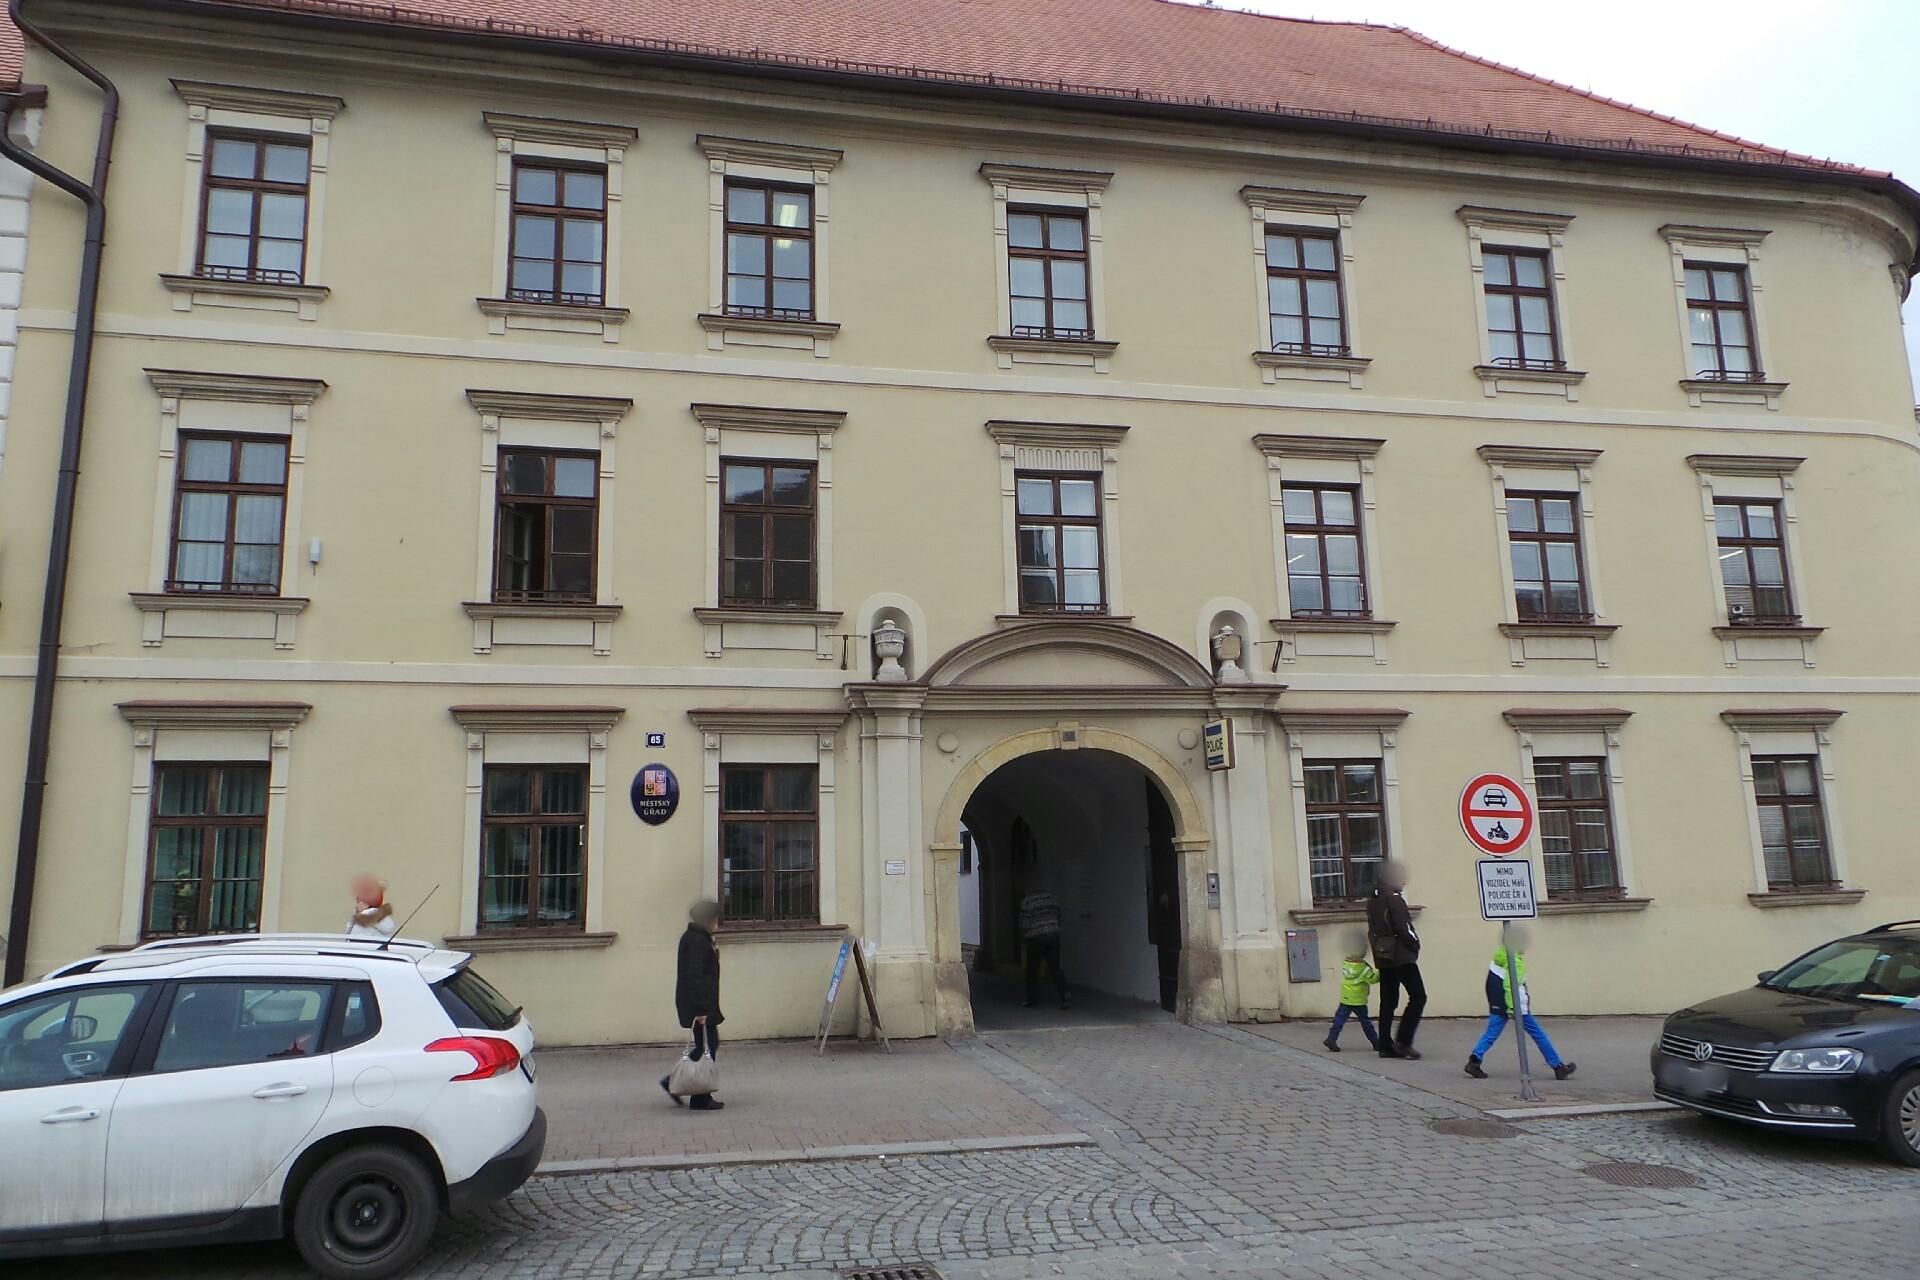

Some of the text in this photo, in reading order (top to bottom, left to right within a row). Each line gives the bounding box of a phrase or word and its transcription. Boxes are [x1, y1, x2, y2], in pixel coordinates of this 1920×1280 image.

[650, 735, 661, 744] 65
[1496, 867, 1513, 876] MIMO
[1486, 879, 1511, 888] VOZIDEL
[1488, 888, 1527, 899] POLICIE ČR A
